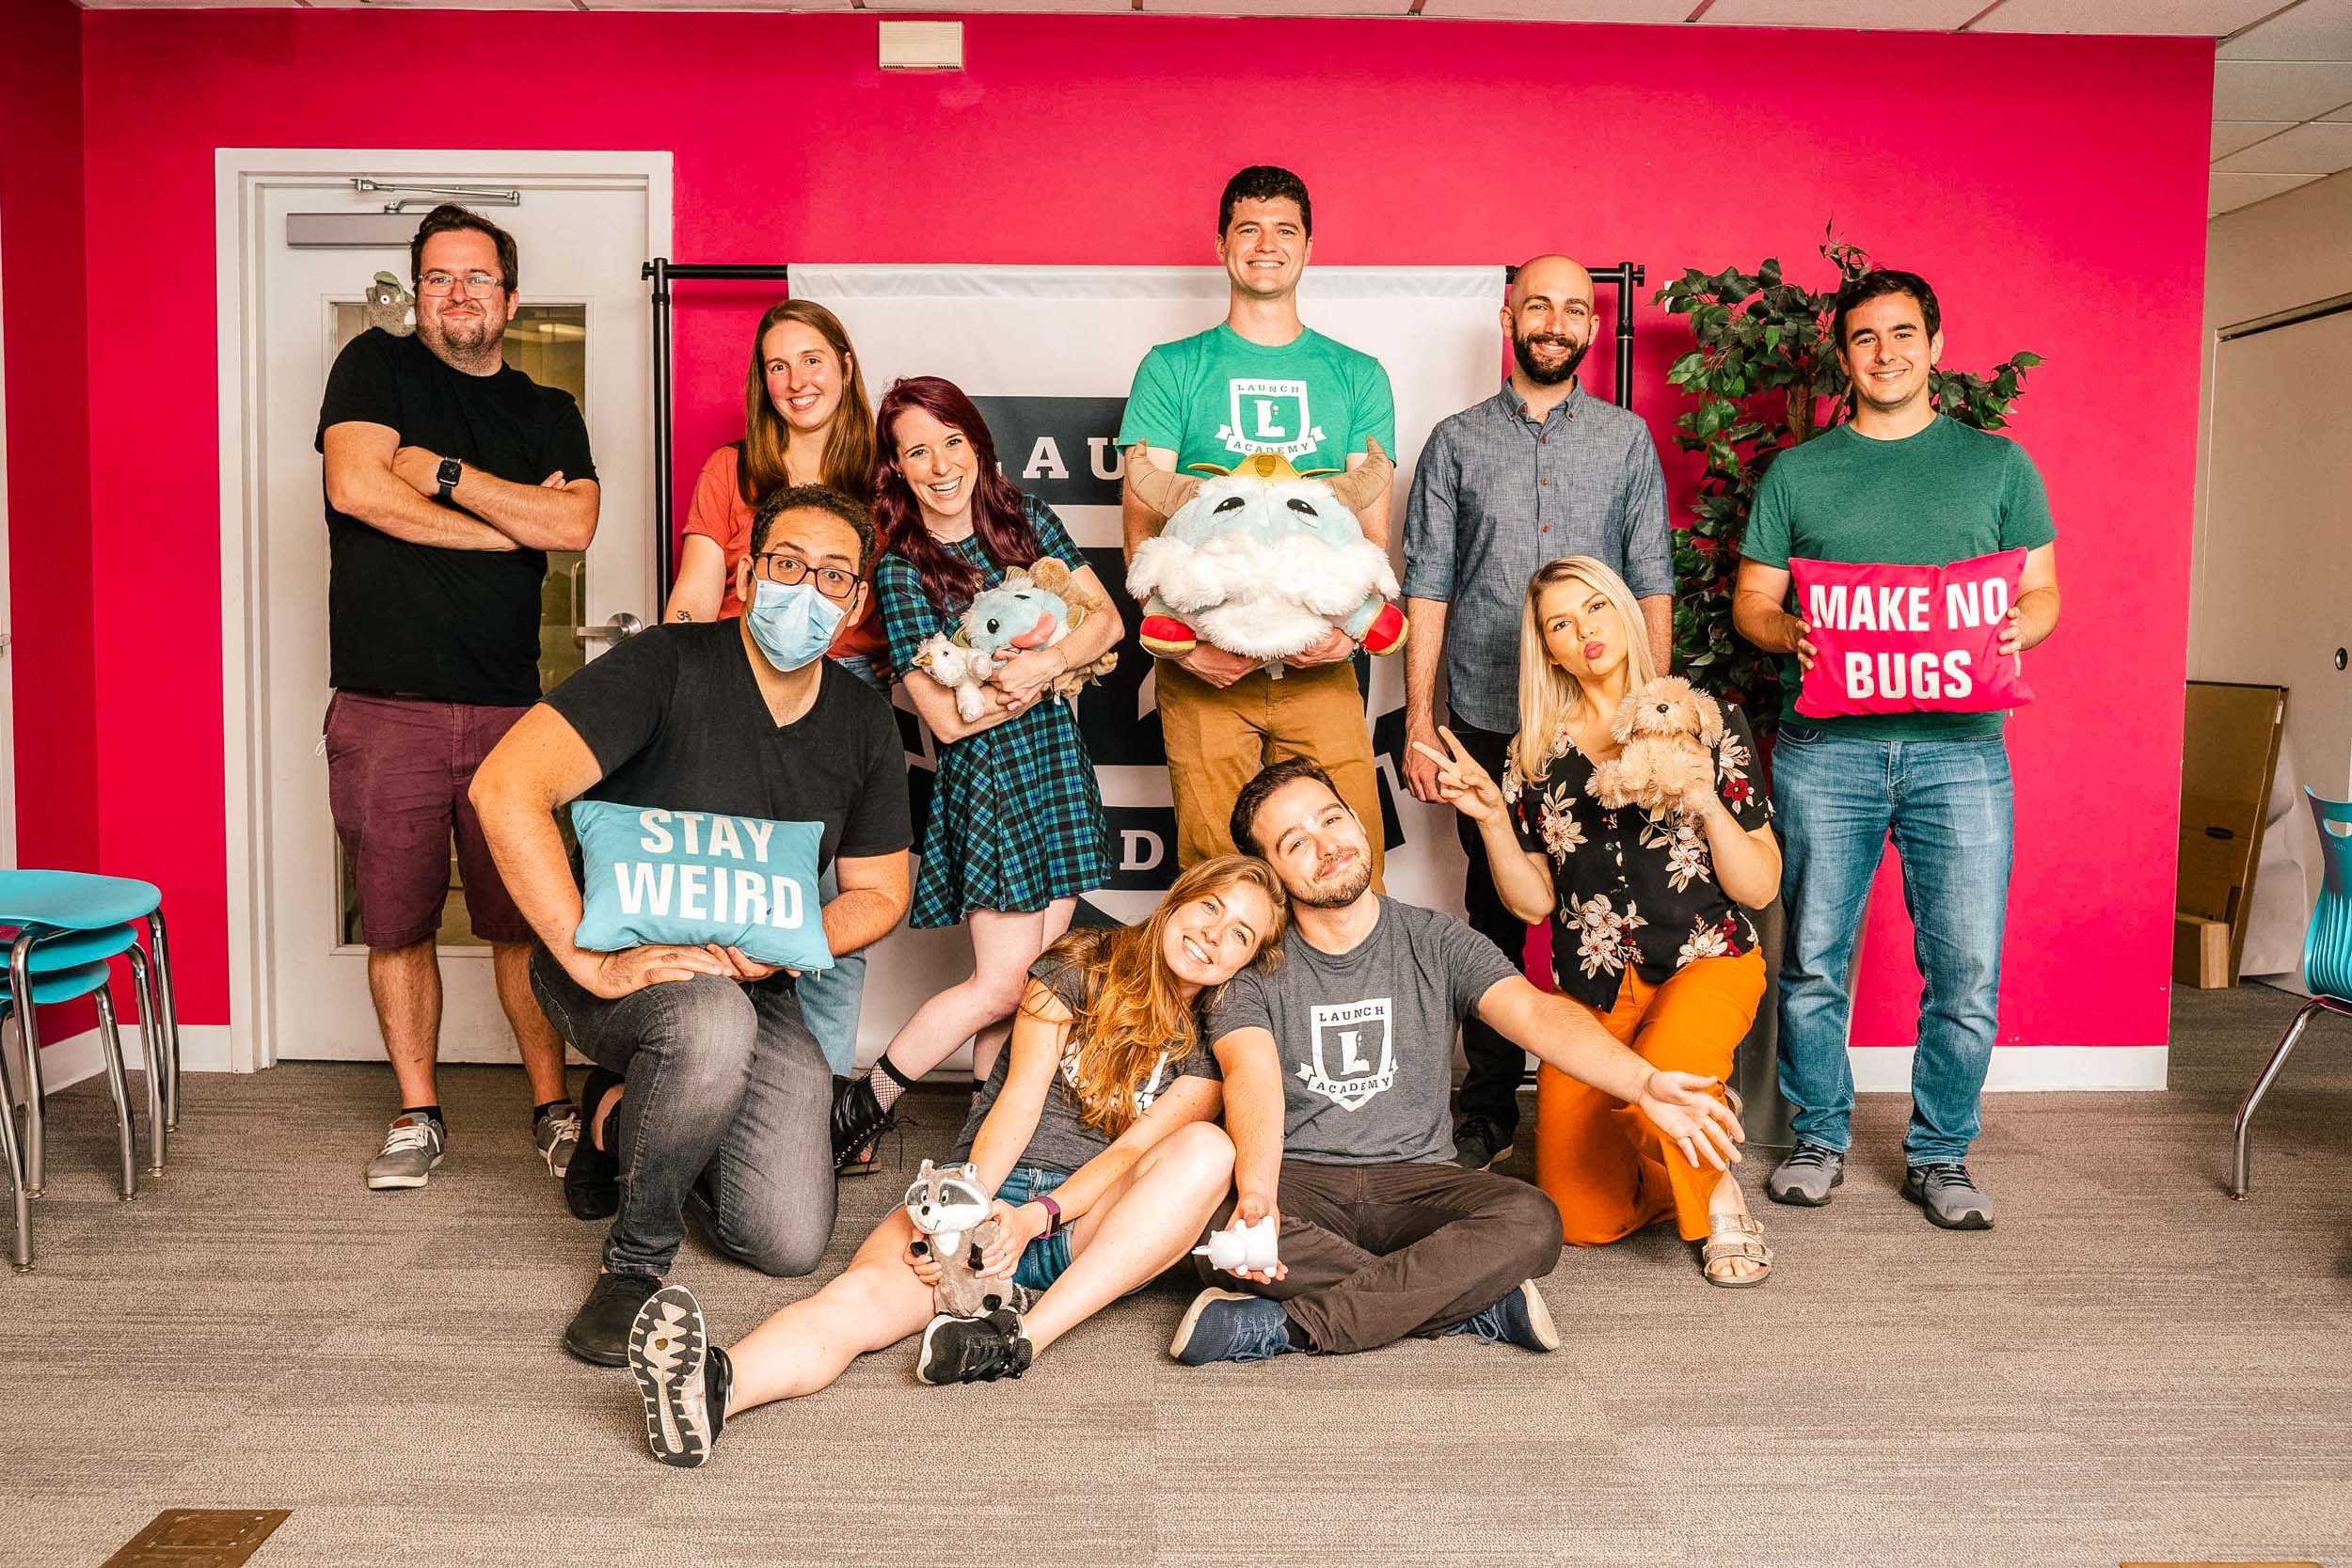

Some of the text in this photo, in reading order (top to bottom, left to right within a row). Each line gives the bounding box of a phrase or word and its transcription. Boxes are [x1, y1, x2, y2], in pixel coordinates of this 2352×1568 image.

[1237, 384, 1299, 393] LAUNCH
[1253, 400, 1286, 437] L
[996, 436, 1125, 481] AU
[1233, 440, 1309, 453] ACADEMY
[1810, 578, 2008, 632] MAKE NO
[1845, 650, 1973, 700] BUGS
[640, 809, 774, 863] STAY
[613, 862, 804, 929] WEIRD
[1319, 1006, 1385, 1022] LAUNCH
[1338, 1030, 1370, 1075] L
[1316, 1077, 1390, 1094] ACADEMY
